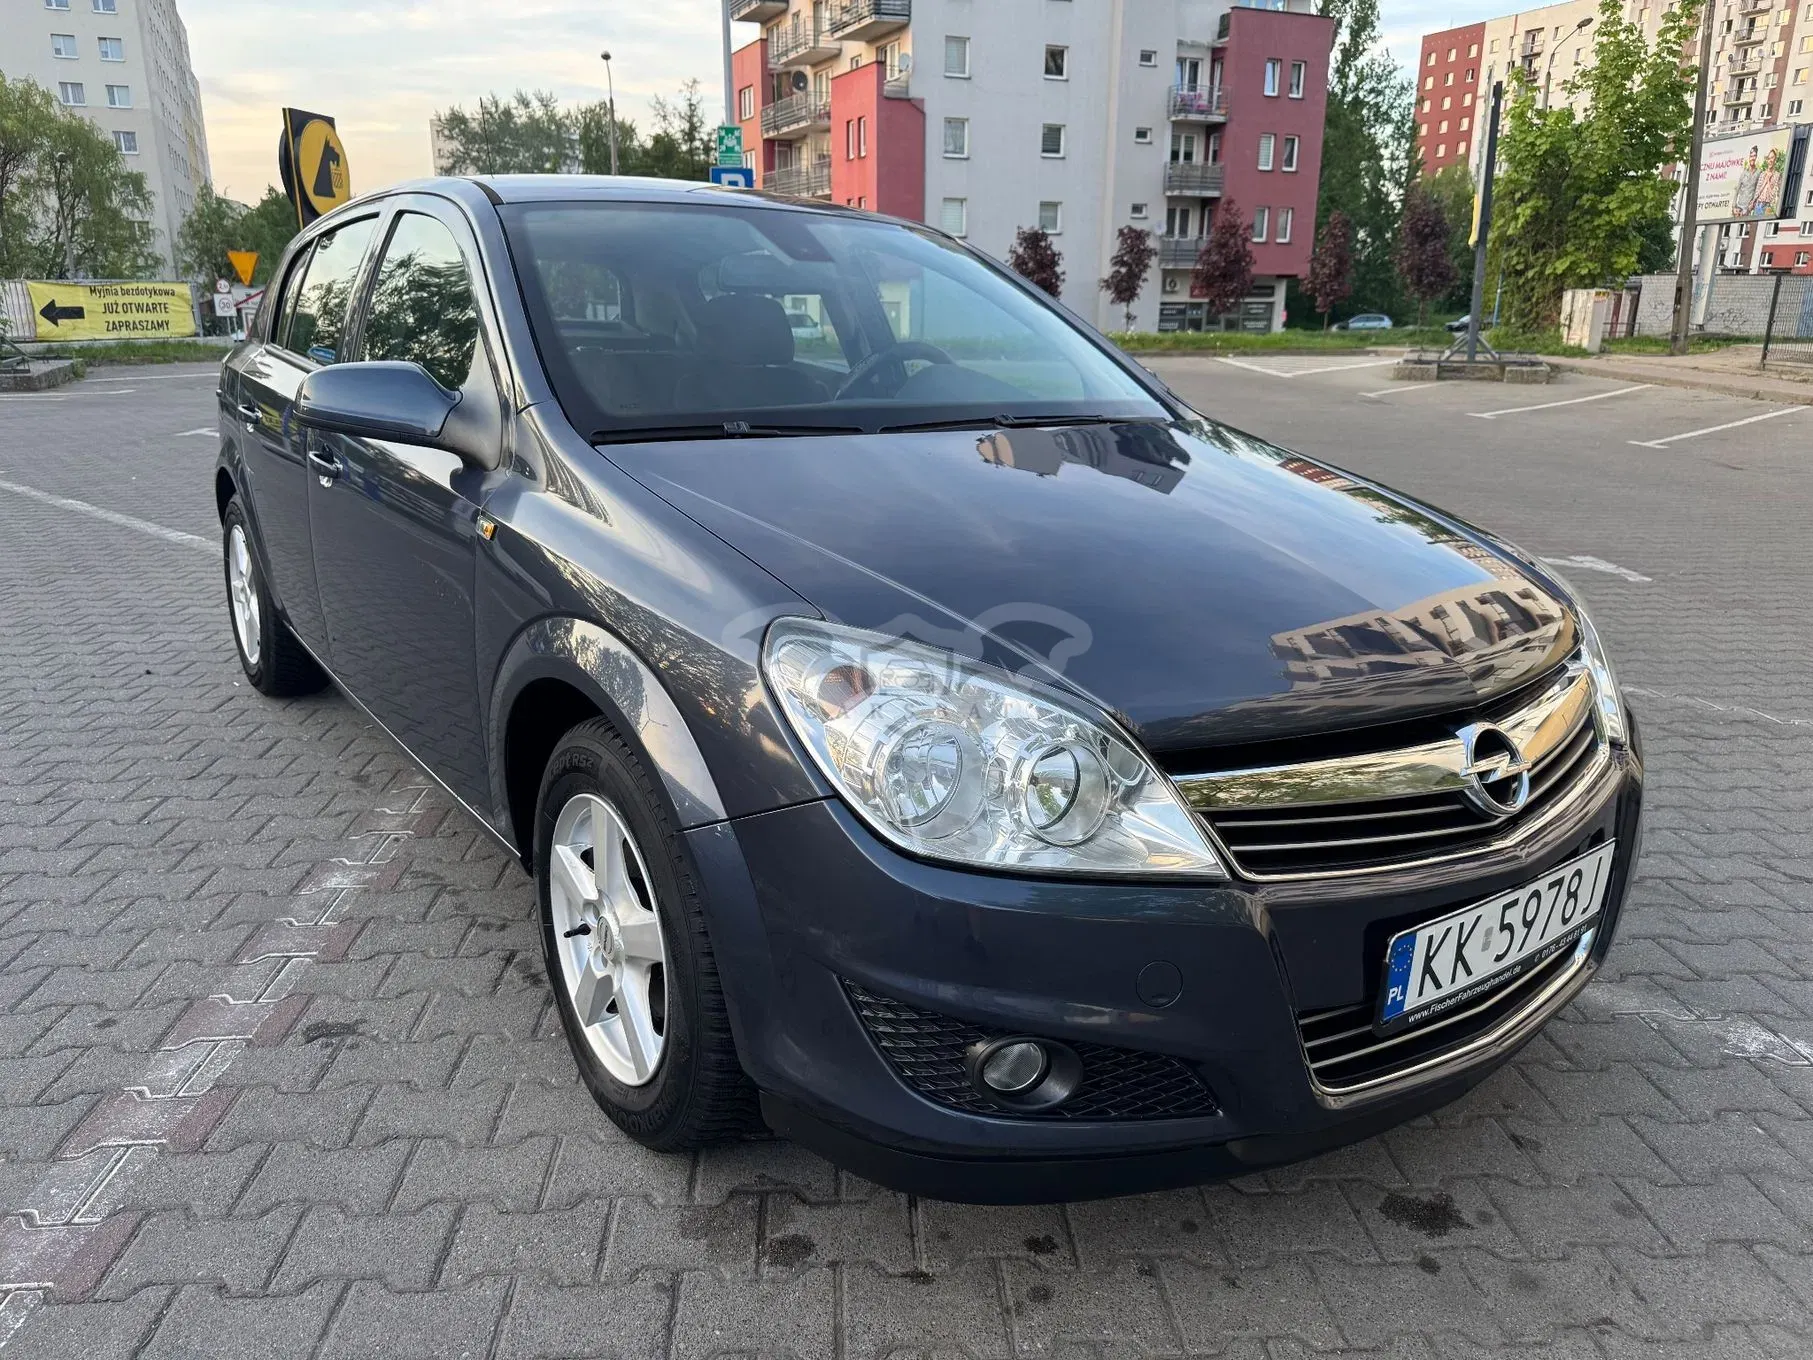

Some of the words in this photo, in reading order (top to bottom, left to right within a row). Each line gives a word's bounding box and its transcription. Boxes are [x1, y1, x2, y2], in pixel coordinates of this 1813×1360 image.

[89, 286, 118, 298] Myjnia
[120, 286, 175, 298] bezdotykowa
[102, 300, 120, 314] JUŻ
[122, 302, 169, 314] OTWARTE
[105, 320, 170, 332] ZAPRASZAMY
[1417, 914, 1483, 998] KK
[1493, 855, 1603, 962] 5978J
[1387, 985, 1404, 1005] PL
